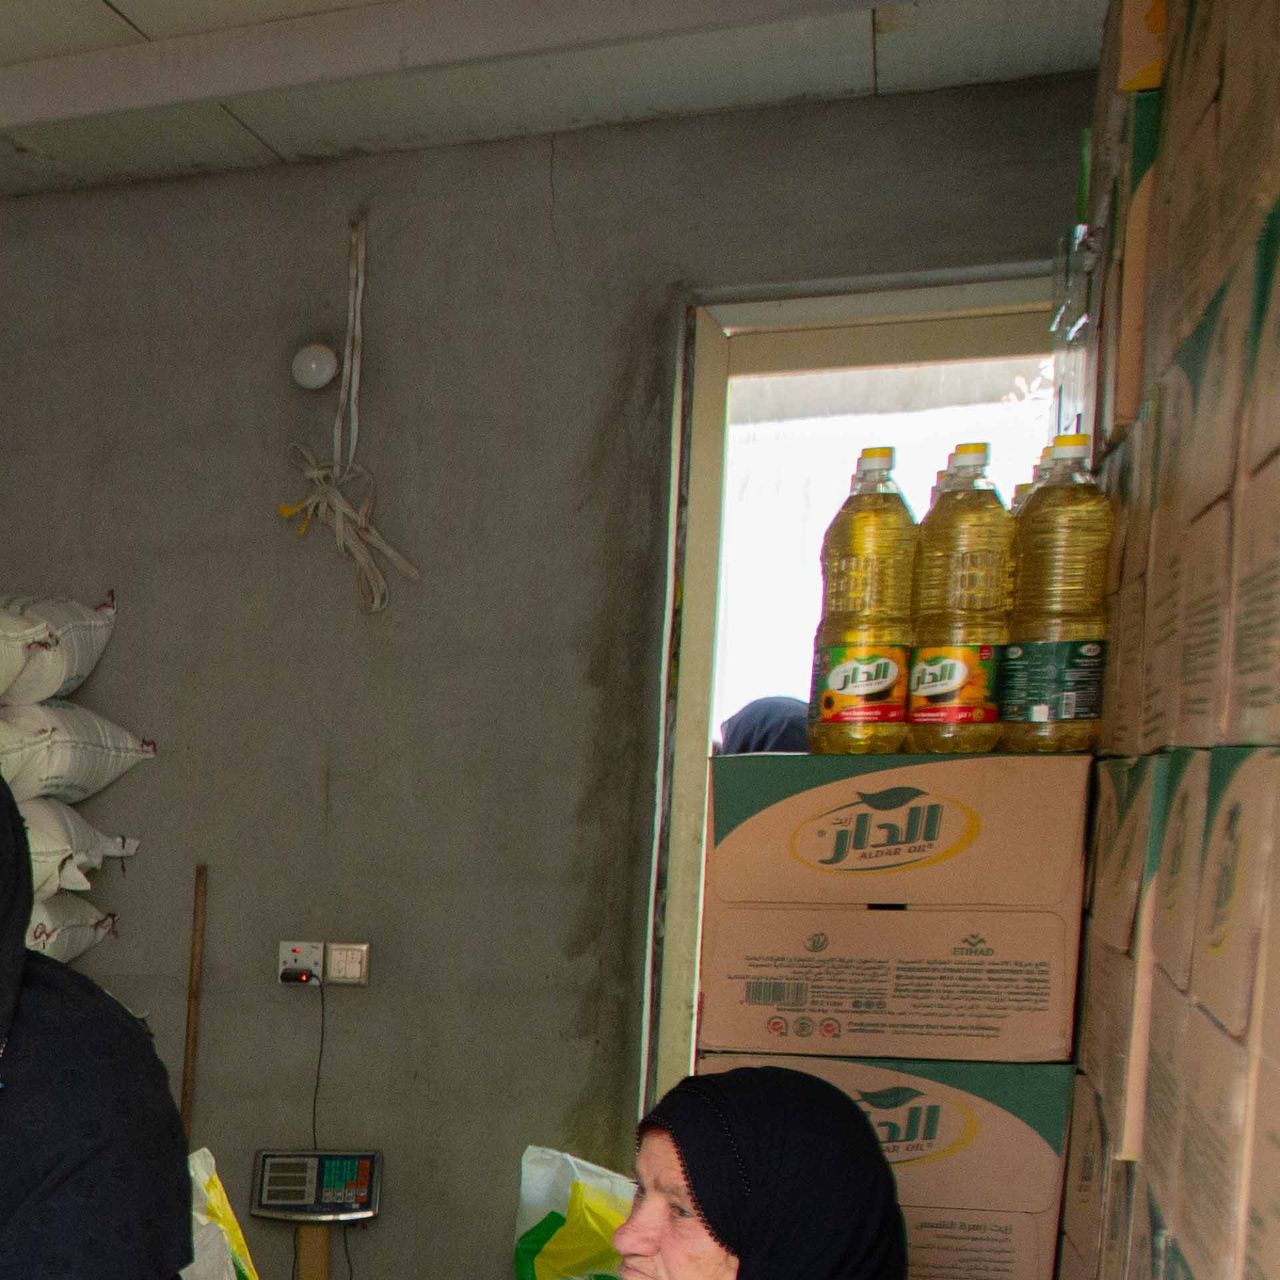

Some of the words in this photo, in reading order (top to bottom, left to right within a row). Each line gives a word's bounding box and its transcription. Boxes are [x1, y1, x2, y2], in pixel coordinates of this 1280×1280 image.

[818, 803, 944, 865] الدار
[859, 846, 902, 861] ALDAR
[953, 947, 995, 957] ETIHAD
